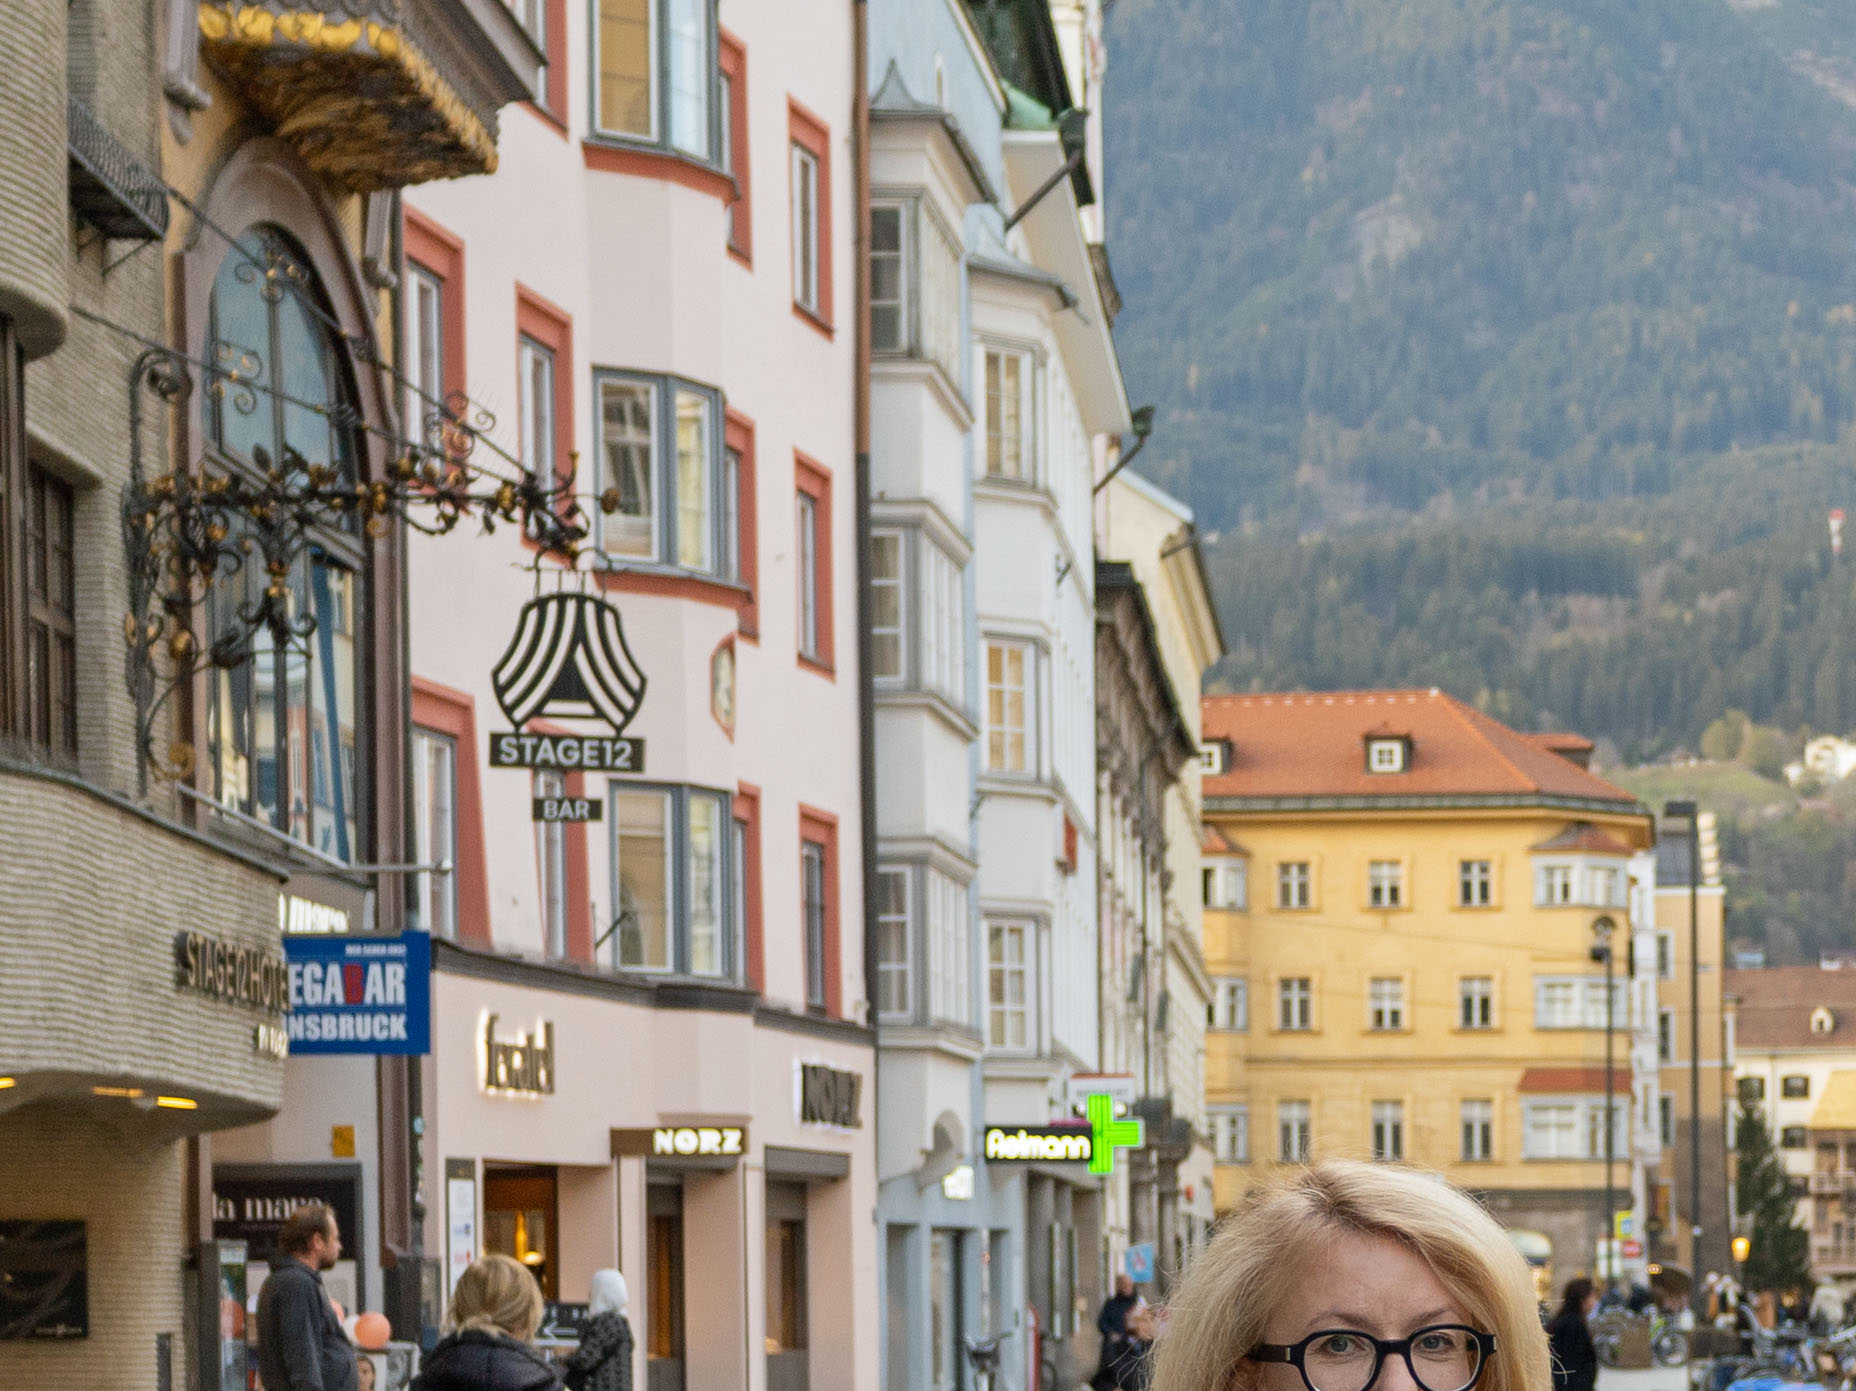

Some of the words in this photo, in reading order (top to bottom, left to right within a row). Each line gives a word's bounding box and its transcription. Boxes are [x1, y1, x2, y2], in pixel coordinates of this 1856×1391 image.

[499, 736, 633, 769] STAGE12
[543, 799, 591, 820] BAR
[287, 961, 406, 1006] EGABAR
[284, 1013, 408, 1040] NSBRUCK
[653, 1128, 743, 1155] NORZ
